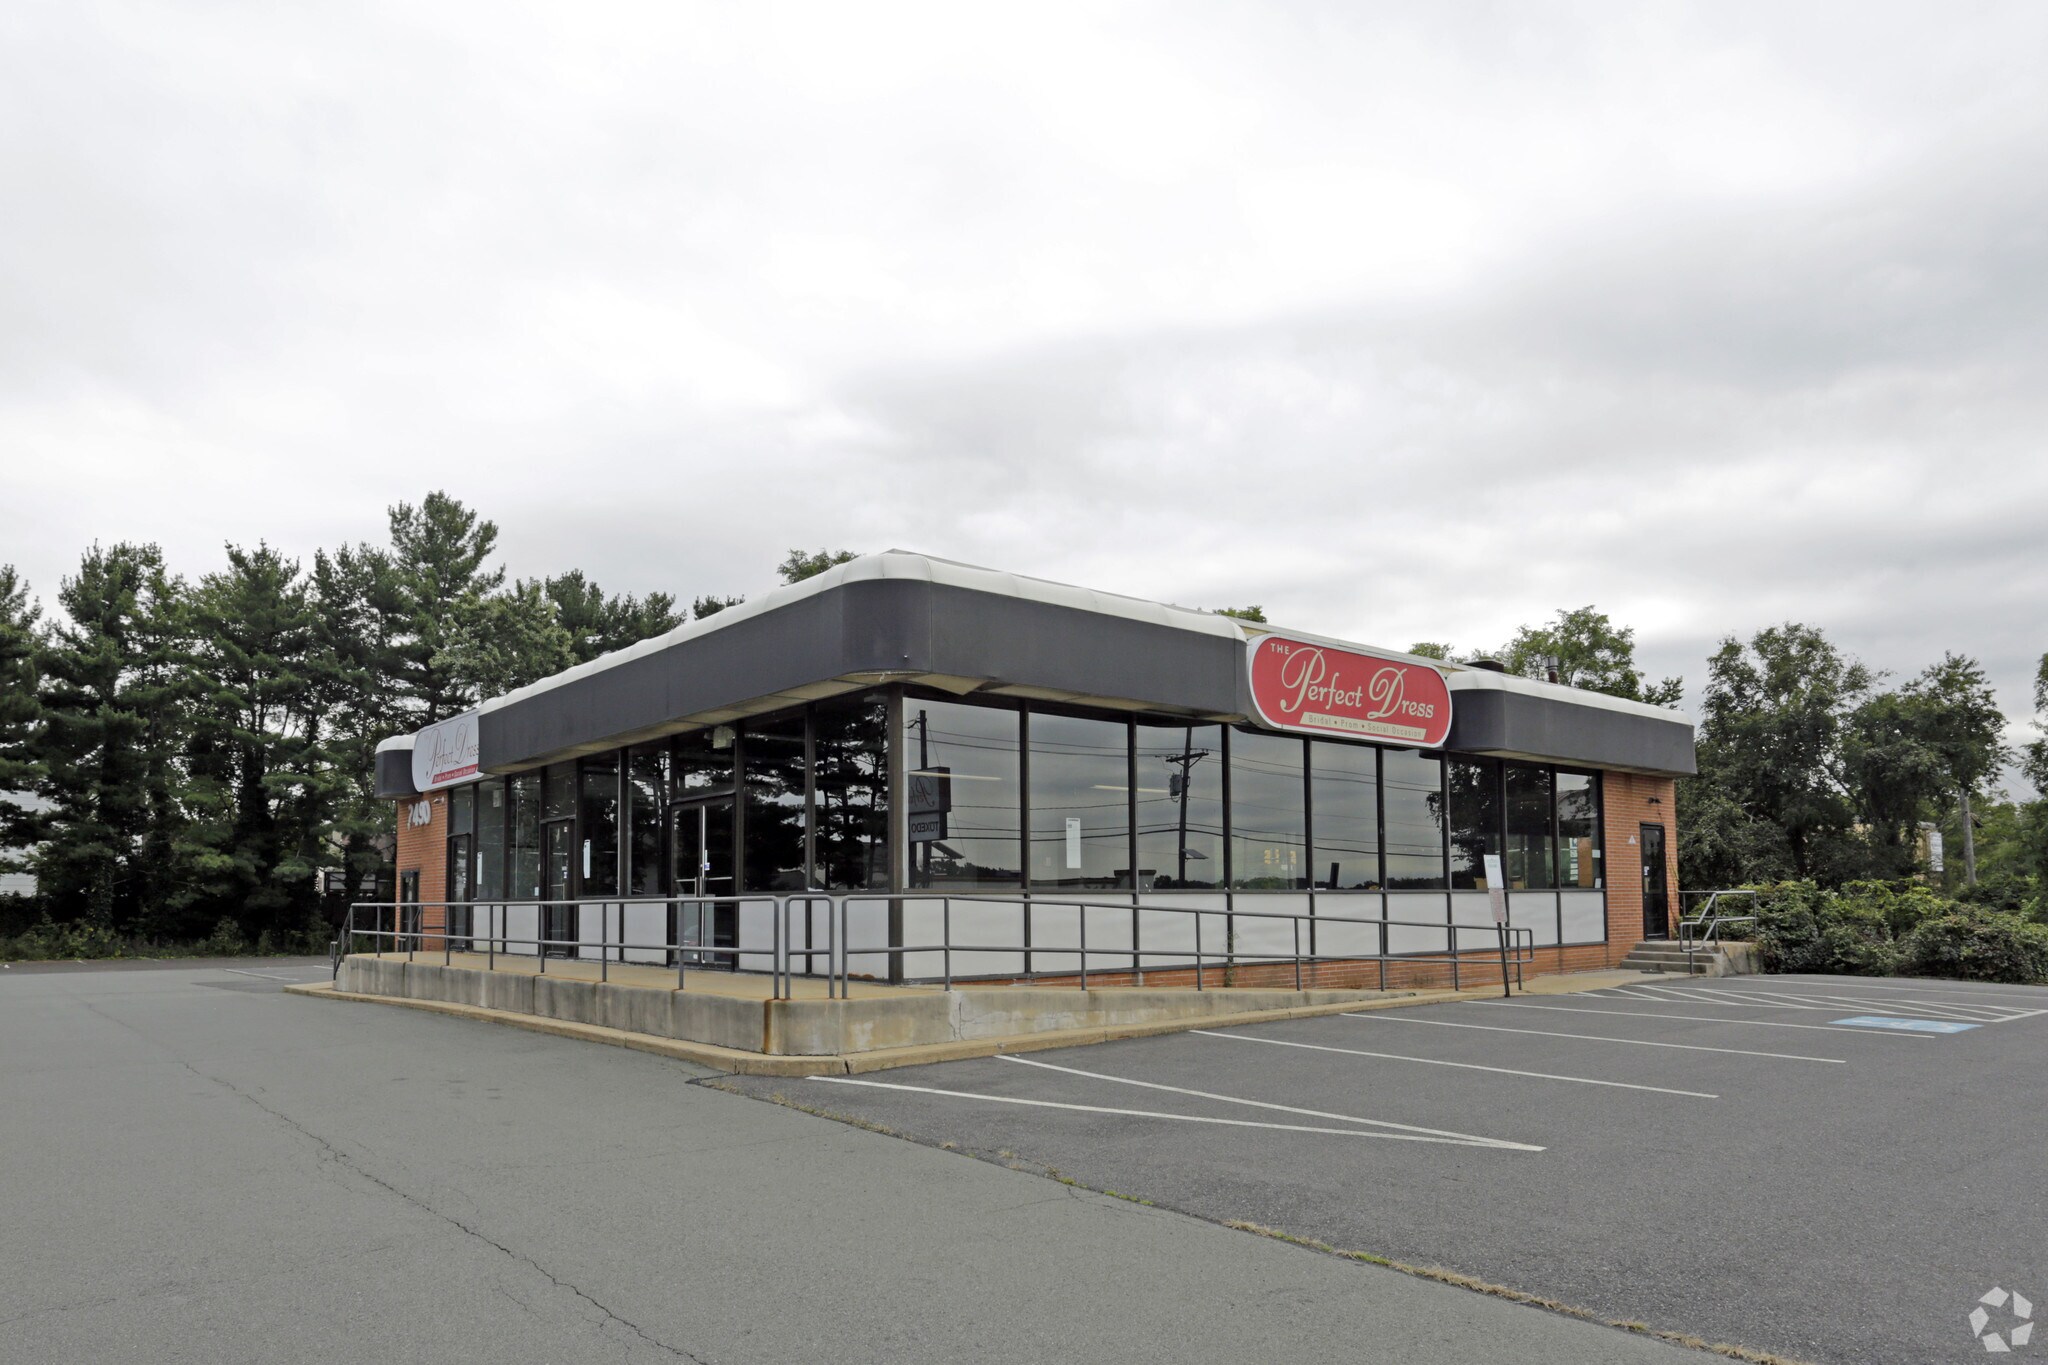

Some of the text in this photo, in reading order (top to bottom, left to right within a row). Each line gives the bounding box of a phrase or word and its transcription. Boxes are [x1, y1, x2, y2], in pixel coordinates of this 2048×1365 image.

[1270, 642, 1290, 655] THE
[1280, 647, 1434, 720] Perfect Dress
[1308, 714, 1422, 738] Bridal Prom Social Occasion
[426, 728, 454, 779] Perfect
